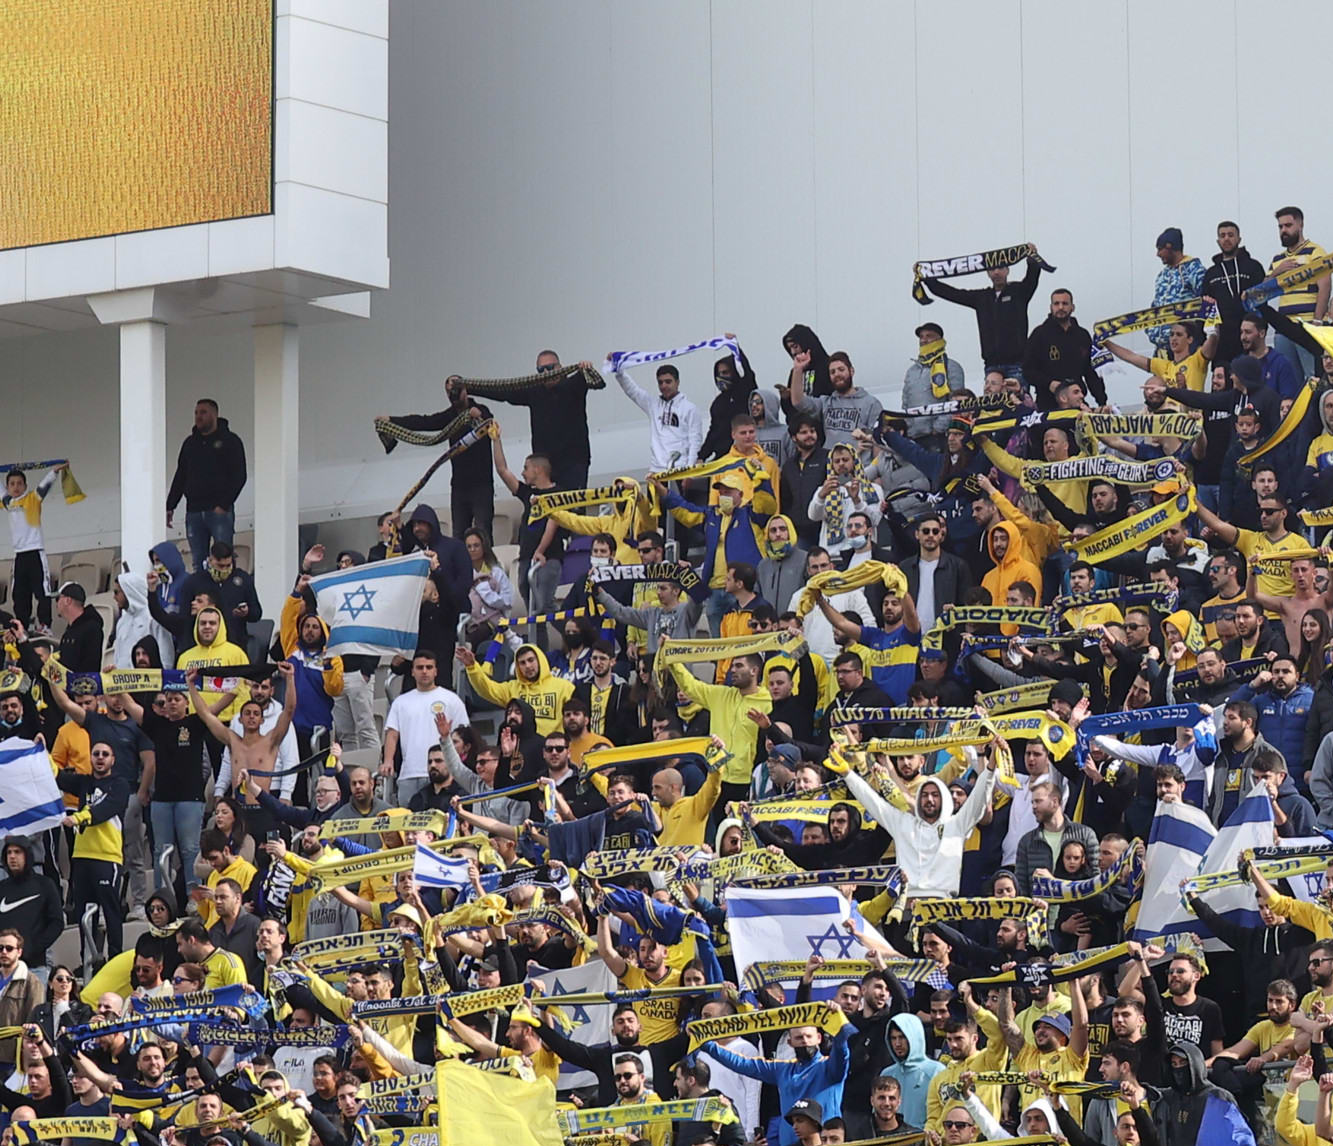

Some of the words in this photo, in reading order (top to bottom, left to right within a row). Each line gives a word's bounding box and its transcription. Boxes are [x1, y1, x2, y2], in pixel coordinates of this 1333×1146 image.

[1090, 414, 1155, 438] MACCABI
[1049, 458, 1103, 481] FIGHTING
[1083, 531, 1126, 560] MACCABI
[111, 673, 141, 685] GROUP
[1133, 710, 1153, 721] תל
[1156, 708, 1190, 720] מכבי
[1099, 714, 1131, 728] אביב
[641, 1000, 675, 1010] ISRAEL
[640, 1009, 678, 1021] CANADA
[691, 1016, 750, 1044] MACCABI
[751, 1011, 773, 1032] TEL
[778, 1006, 811, 1030] AVIV
[811, 1003, 831, 1026] FC
